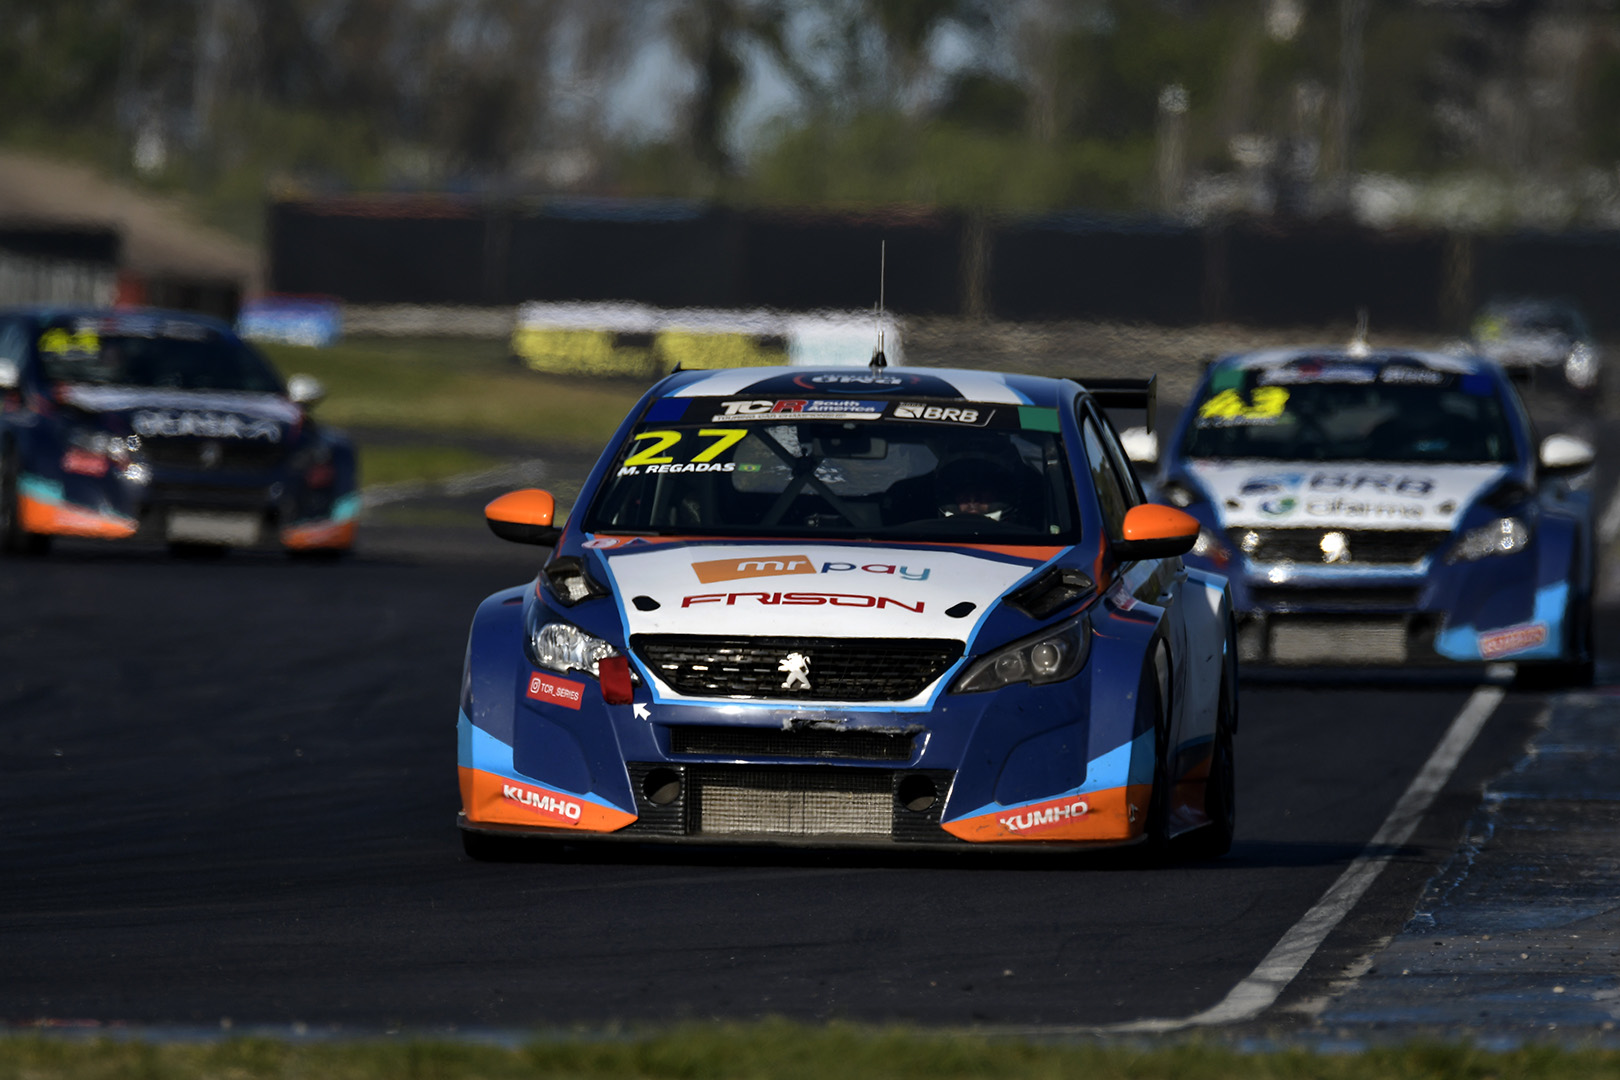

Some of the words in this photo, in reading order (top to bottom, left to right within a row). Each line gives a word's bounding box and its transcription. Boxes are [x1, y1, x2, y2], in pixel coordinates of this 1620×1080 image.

[721, 400, 808, 416] TCR
[923, 406, 980, 423] BRB
[623, 428, 749, 467] 27
[616, 465, 640, 477] M.
[645, 462, 736, 474] REGADAS
[681, 592, 925, 614] FRISON
[541, 682, 580, 701] TCR_SERIES
[503, 784, 581, 819] KUMHO
[1000, 801, 1088, 831] KUMHO
